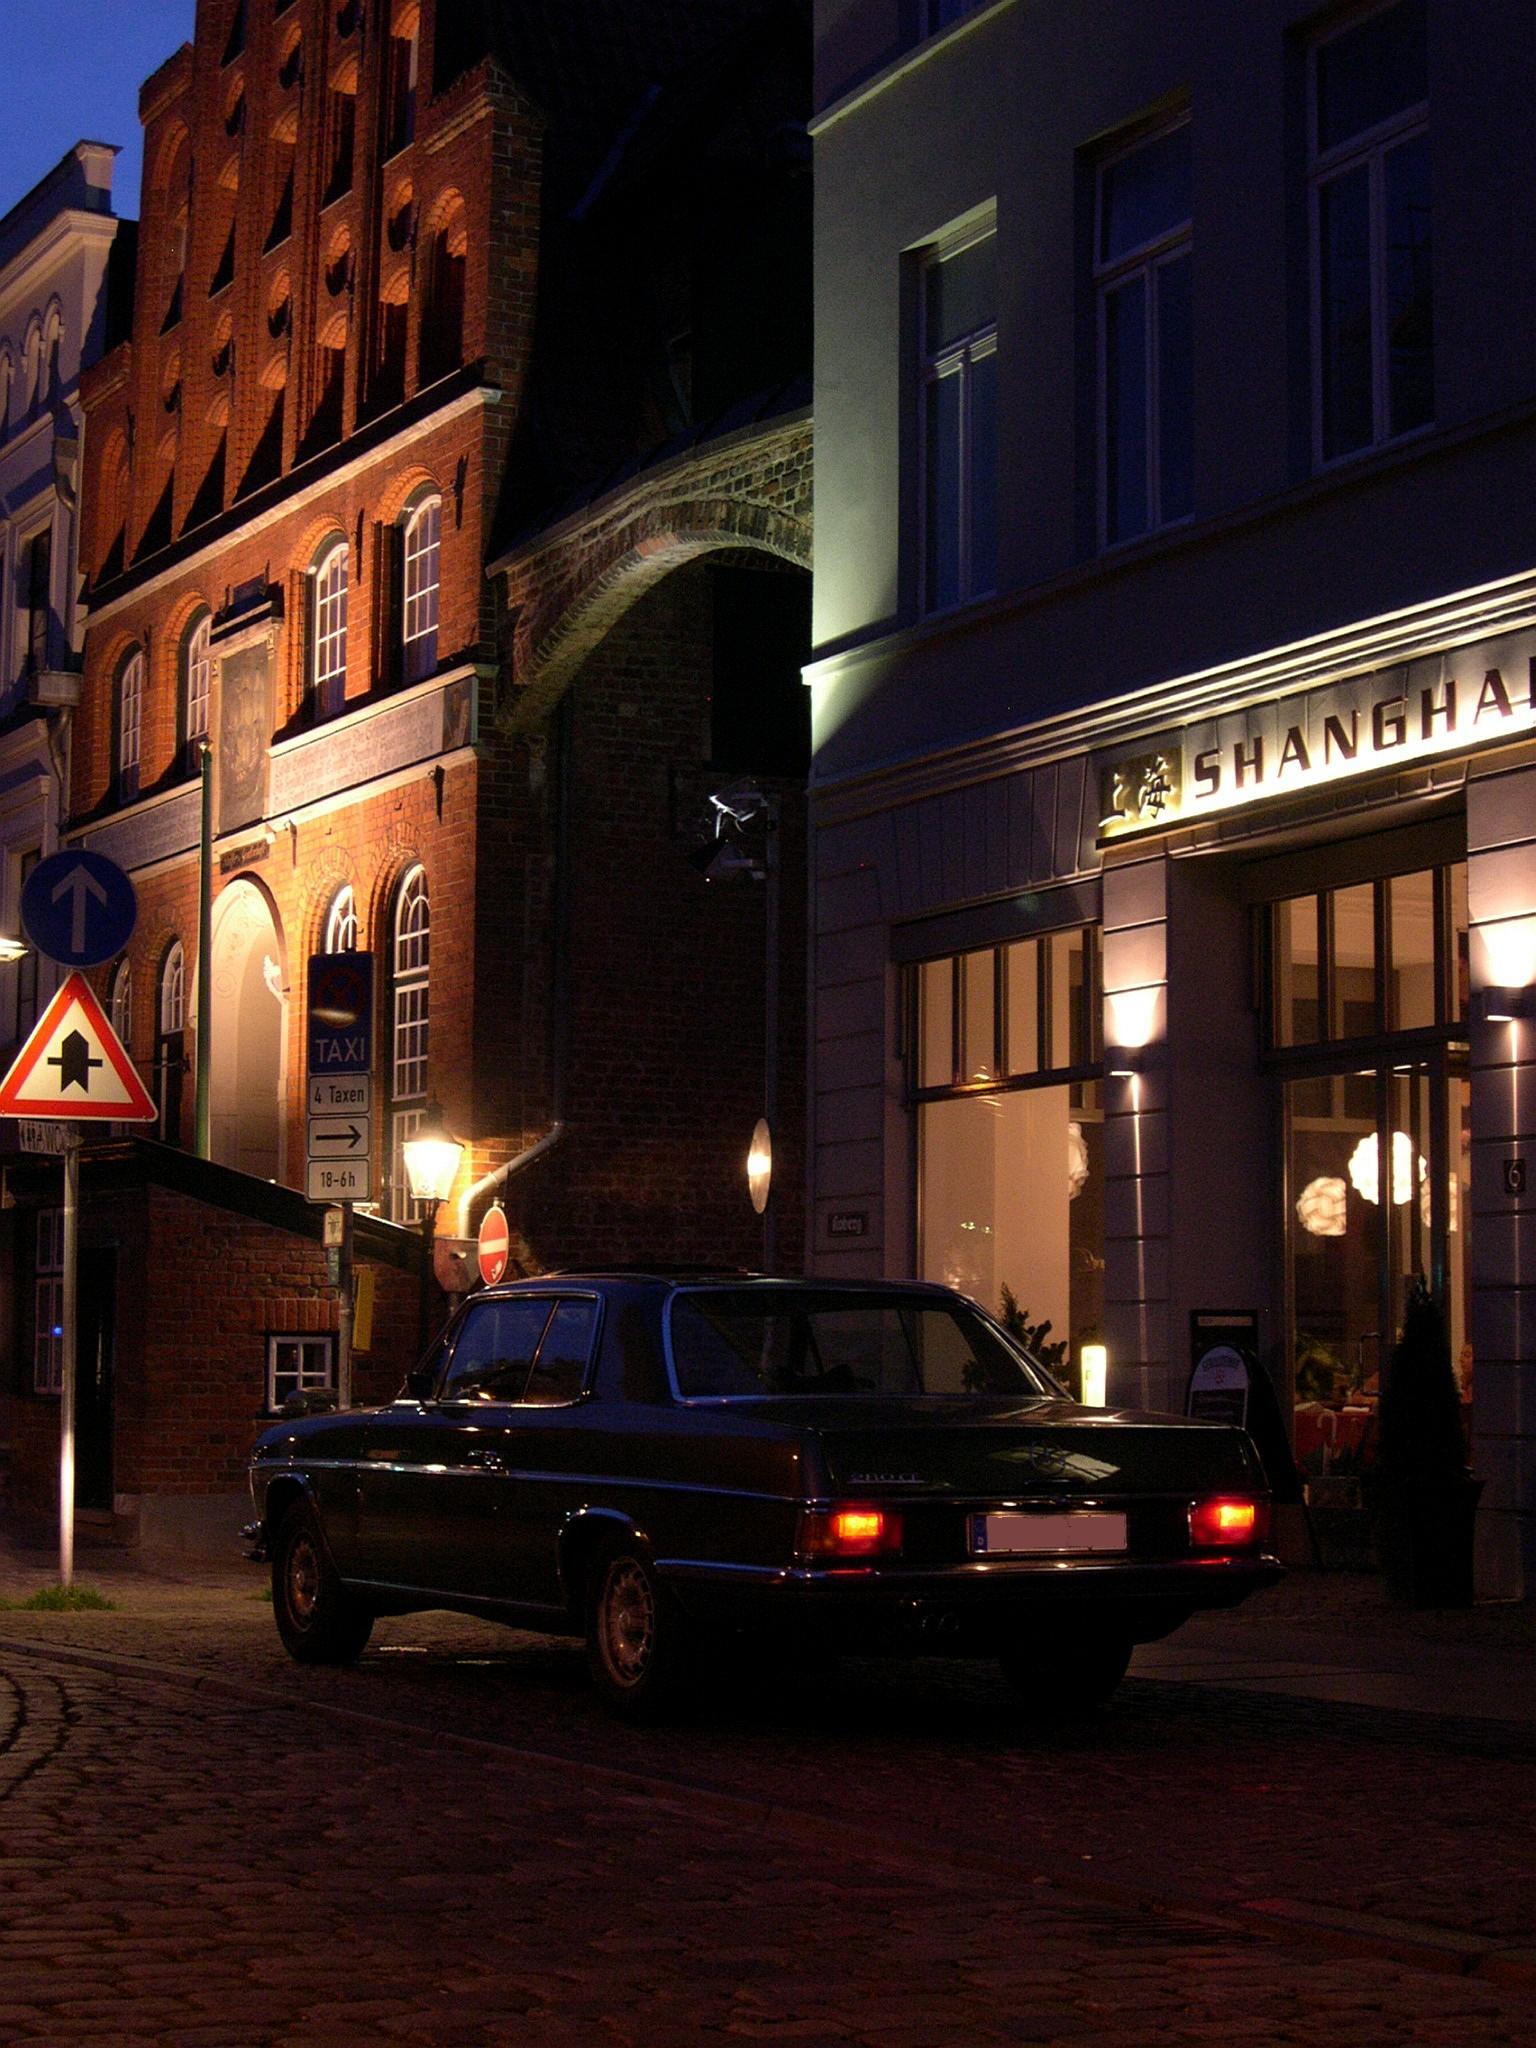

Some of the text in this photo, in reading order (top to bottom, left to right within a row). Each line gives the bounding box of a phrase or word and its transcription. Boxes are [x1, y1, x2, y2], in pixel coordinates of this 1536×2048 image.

[1098, 756, 1177, 827] 上海
[314, 1037, 366, 1063] TAXI
[314, 1085, 365, 1104] 4 Taxen
[1508, 1162, 1521, 1188] 6
